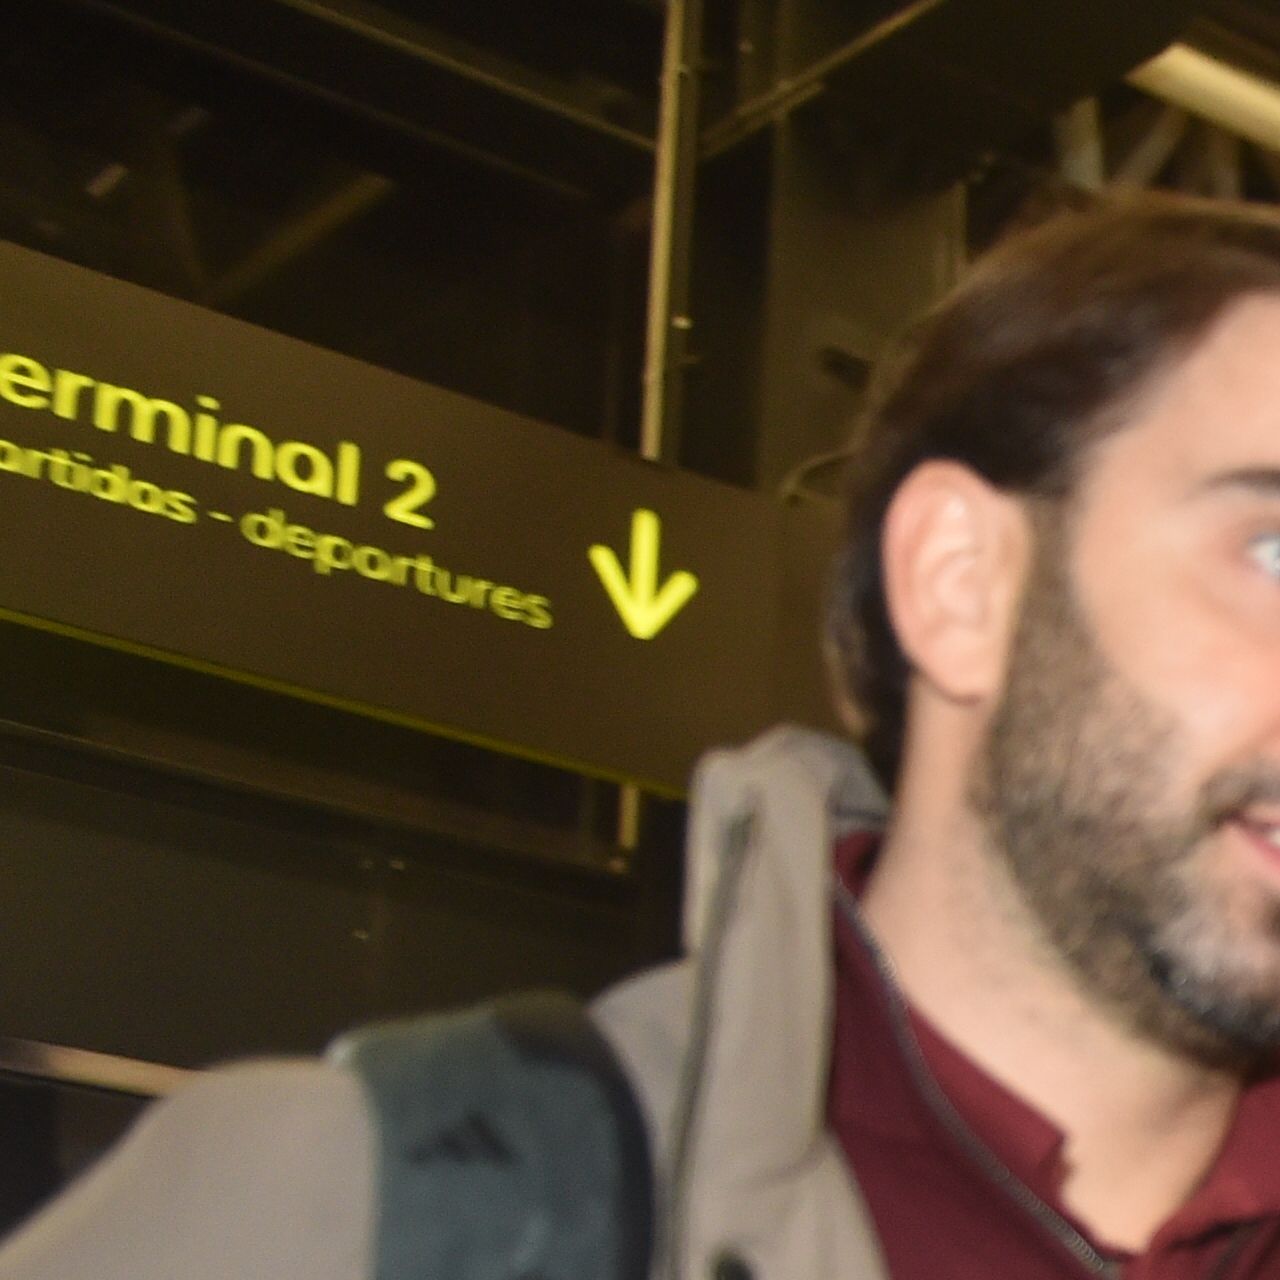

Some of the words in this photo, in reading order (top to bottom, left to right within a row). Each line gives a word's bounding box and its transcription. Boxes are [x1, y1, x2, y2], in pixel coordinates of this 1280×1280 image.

[0, 353, 360, 506] erminal
[382, 458, 437, 530] 2
[239, 507, 554, 629] departures
